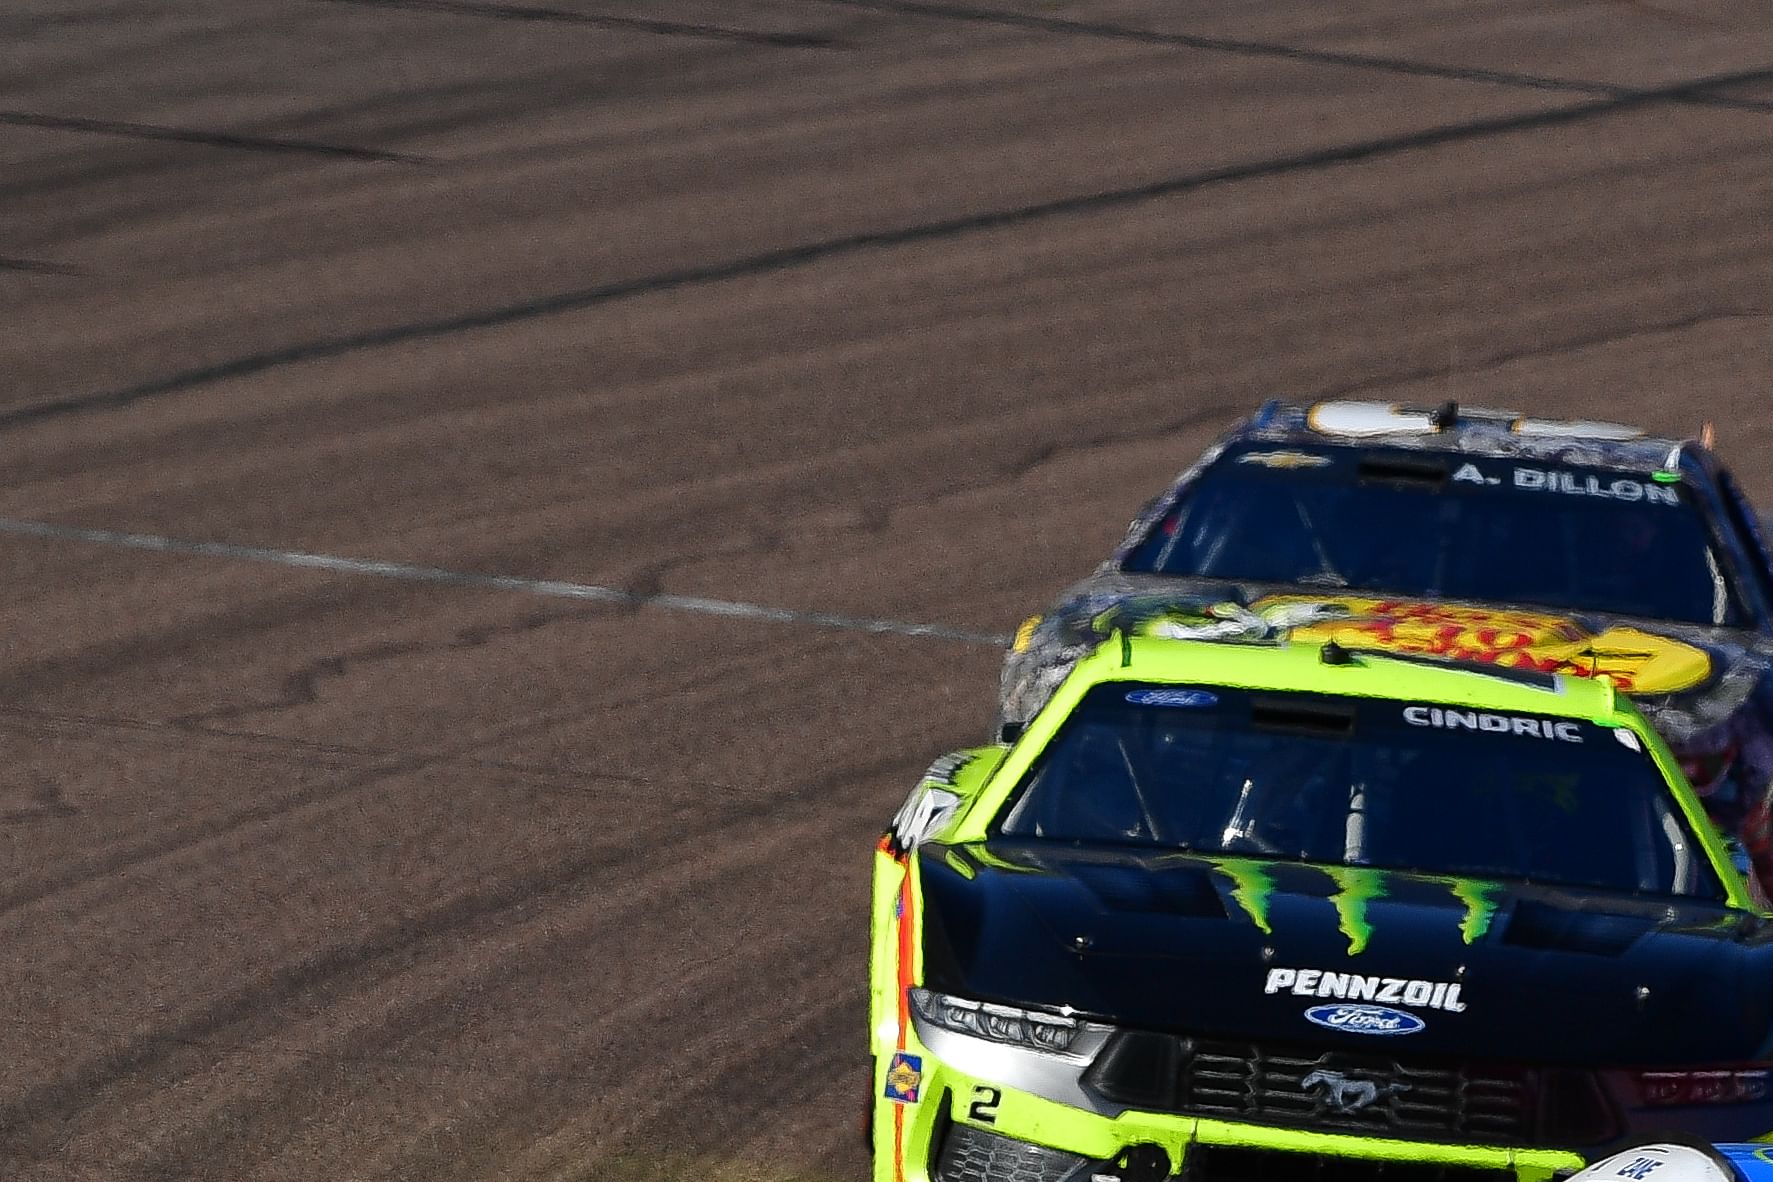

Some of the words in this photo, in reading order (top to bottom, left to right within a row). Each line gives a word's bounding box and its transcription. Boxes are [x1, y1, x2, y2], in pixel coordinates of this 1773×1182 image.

[1452, 462, 1501, 485] A.
[1513, 467, 1681, 507] DILLON
[1402, 705, 1585, 744] CINDRIC
[1264, 967, 1467, 1013] PENNZOIL
[967, 1085, 1002, 1125] 2
